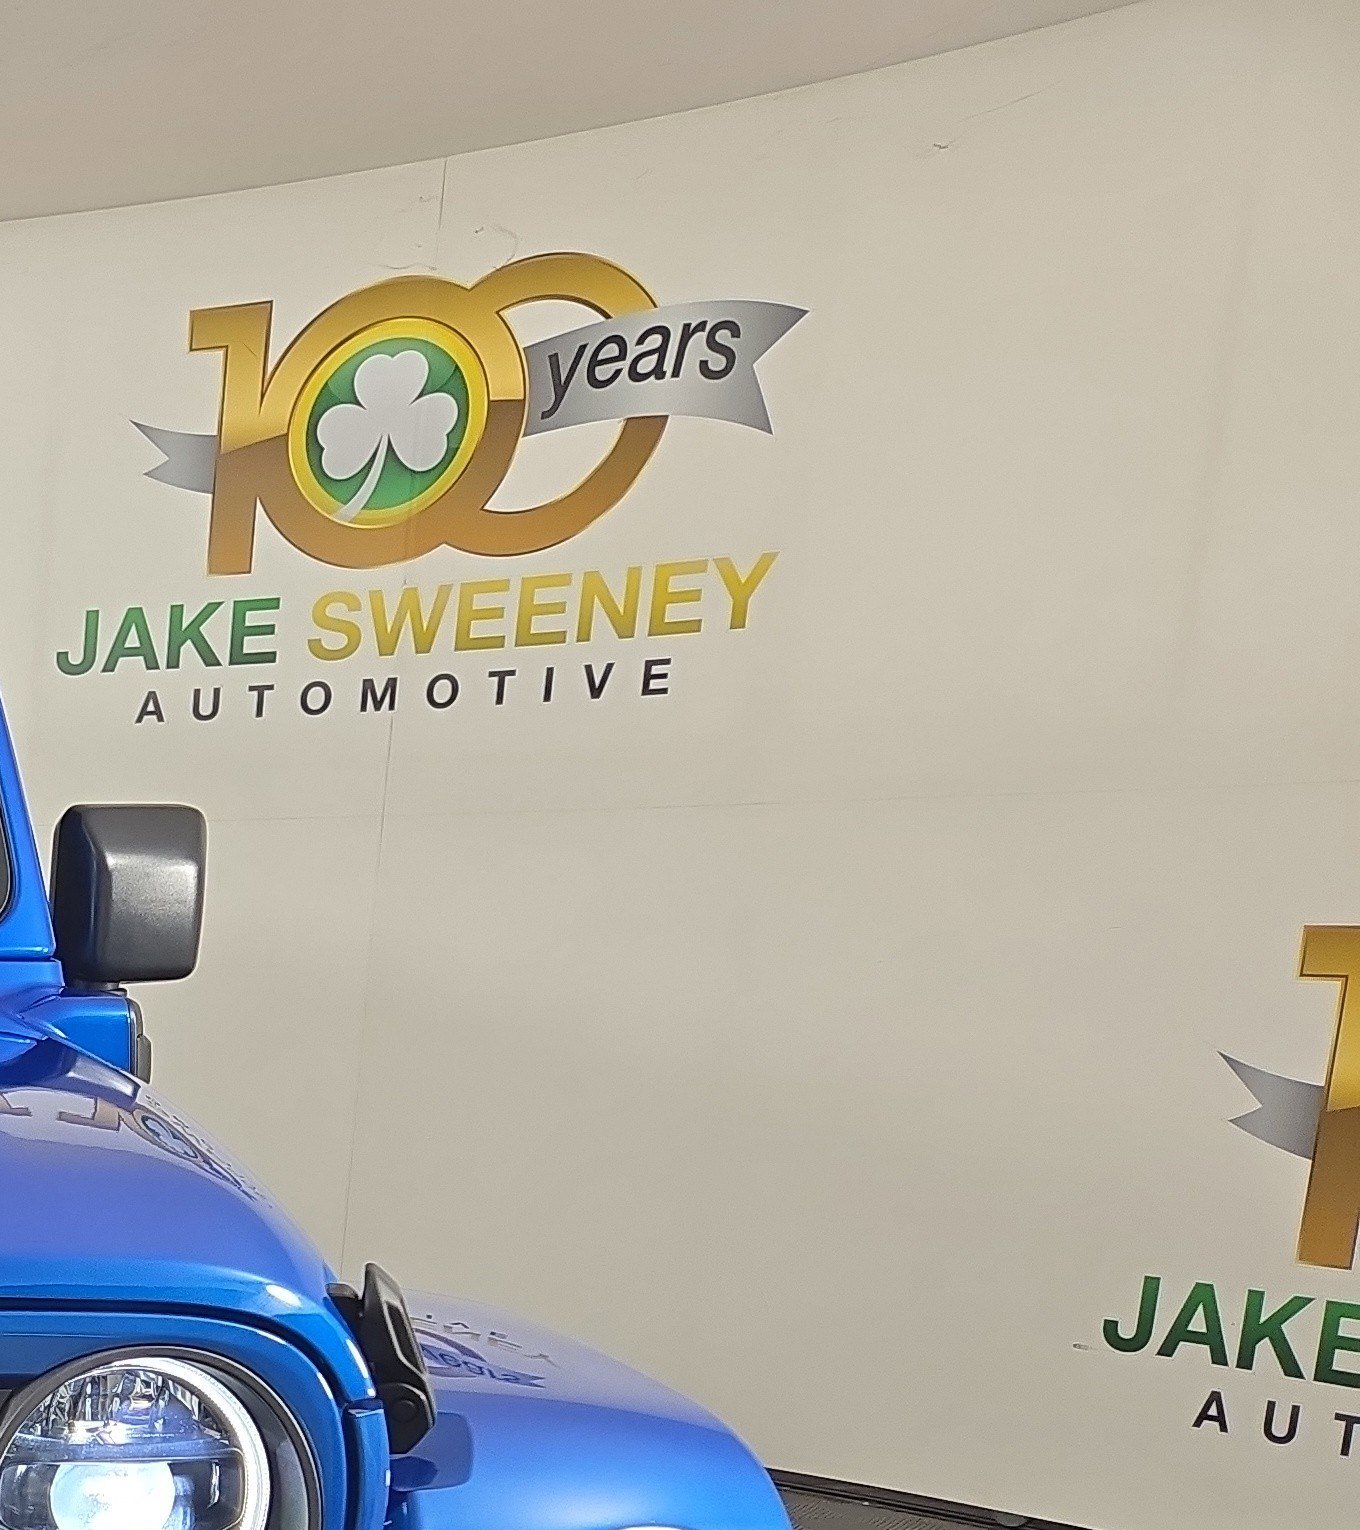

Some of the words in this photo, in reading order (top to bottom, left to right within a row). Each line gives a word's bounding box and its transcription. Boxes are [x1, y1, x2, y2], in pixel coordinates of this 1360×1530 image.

[188, 252, 670, 577] 100
[540, 316, 742, 419] years
[55, 597, 281, 678] JAKE
[306, 551, 781, 663] SWEENEY
[135, 657, 673, 725] AUTOMOTIVE
[1101, 1275, 1360, 1389] JAKE
